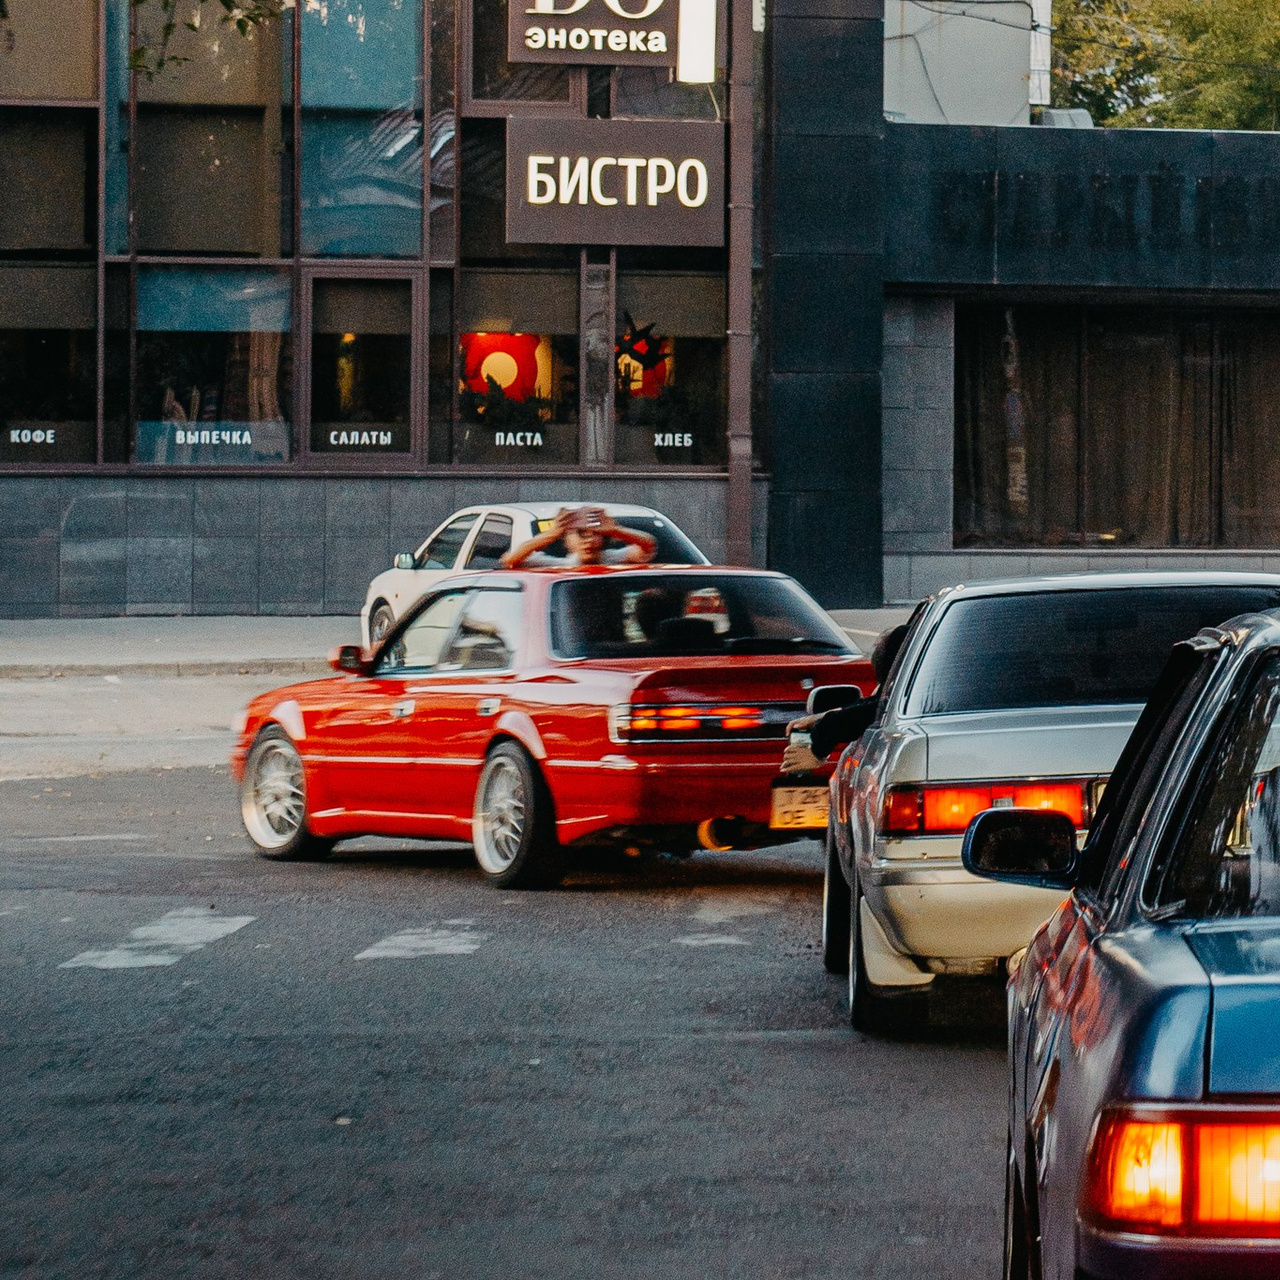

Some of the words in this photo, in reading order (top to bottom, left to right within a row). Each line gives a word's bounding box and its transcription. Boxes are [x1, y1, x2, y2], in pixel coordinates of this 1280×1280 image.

[525, 26, 668, 54] энотека
[526, 155, 708, 208] БИСТРО
[10, 429, 56, 444] КОФЕ
[175, 430, 252, 445] ВЫПЕЧКА
[329, 431, 392, 446] САЛАТЫ
[494, 432, 543, 447] ПАСТА
[653, 433, 693, 447] ХЛЕБ
